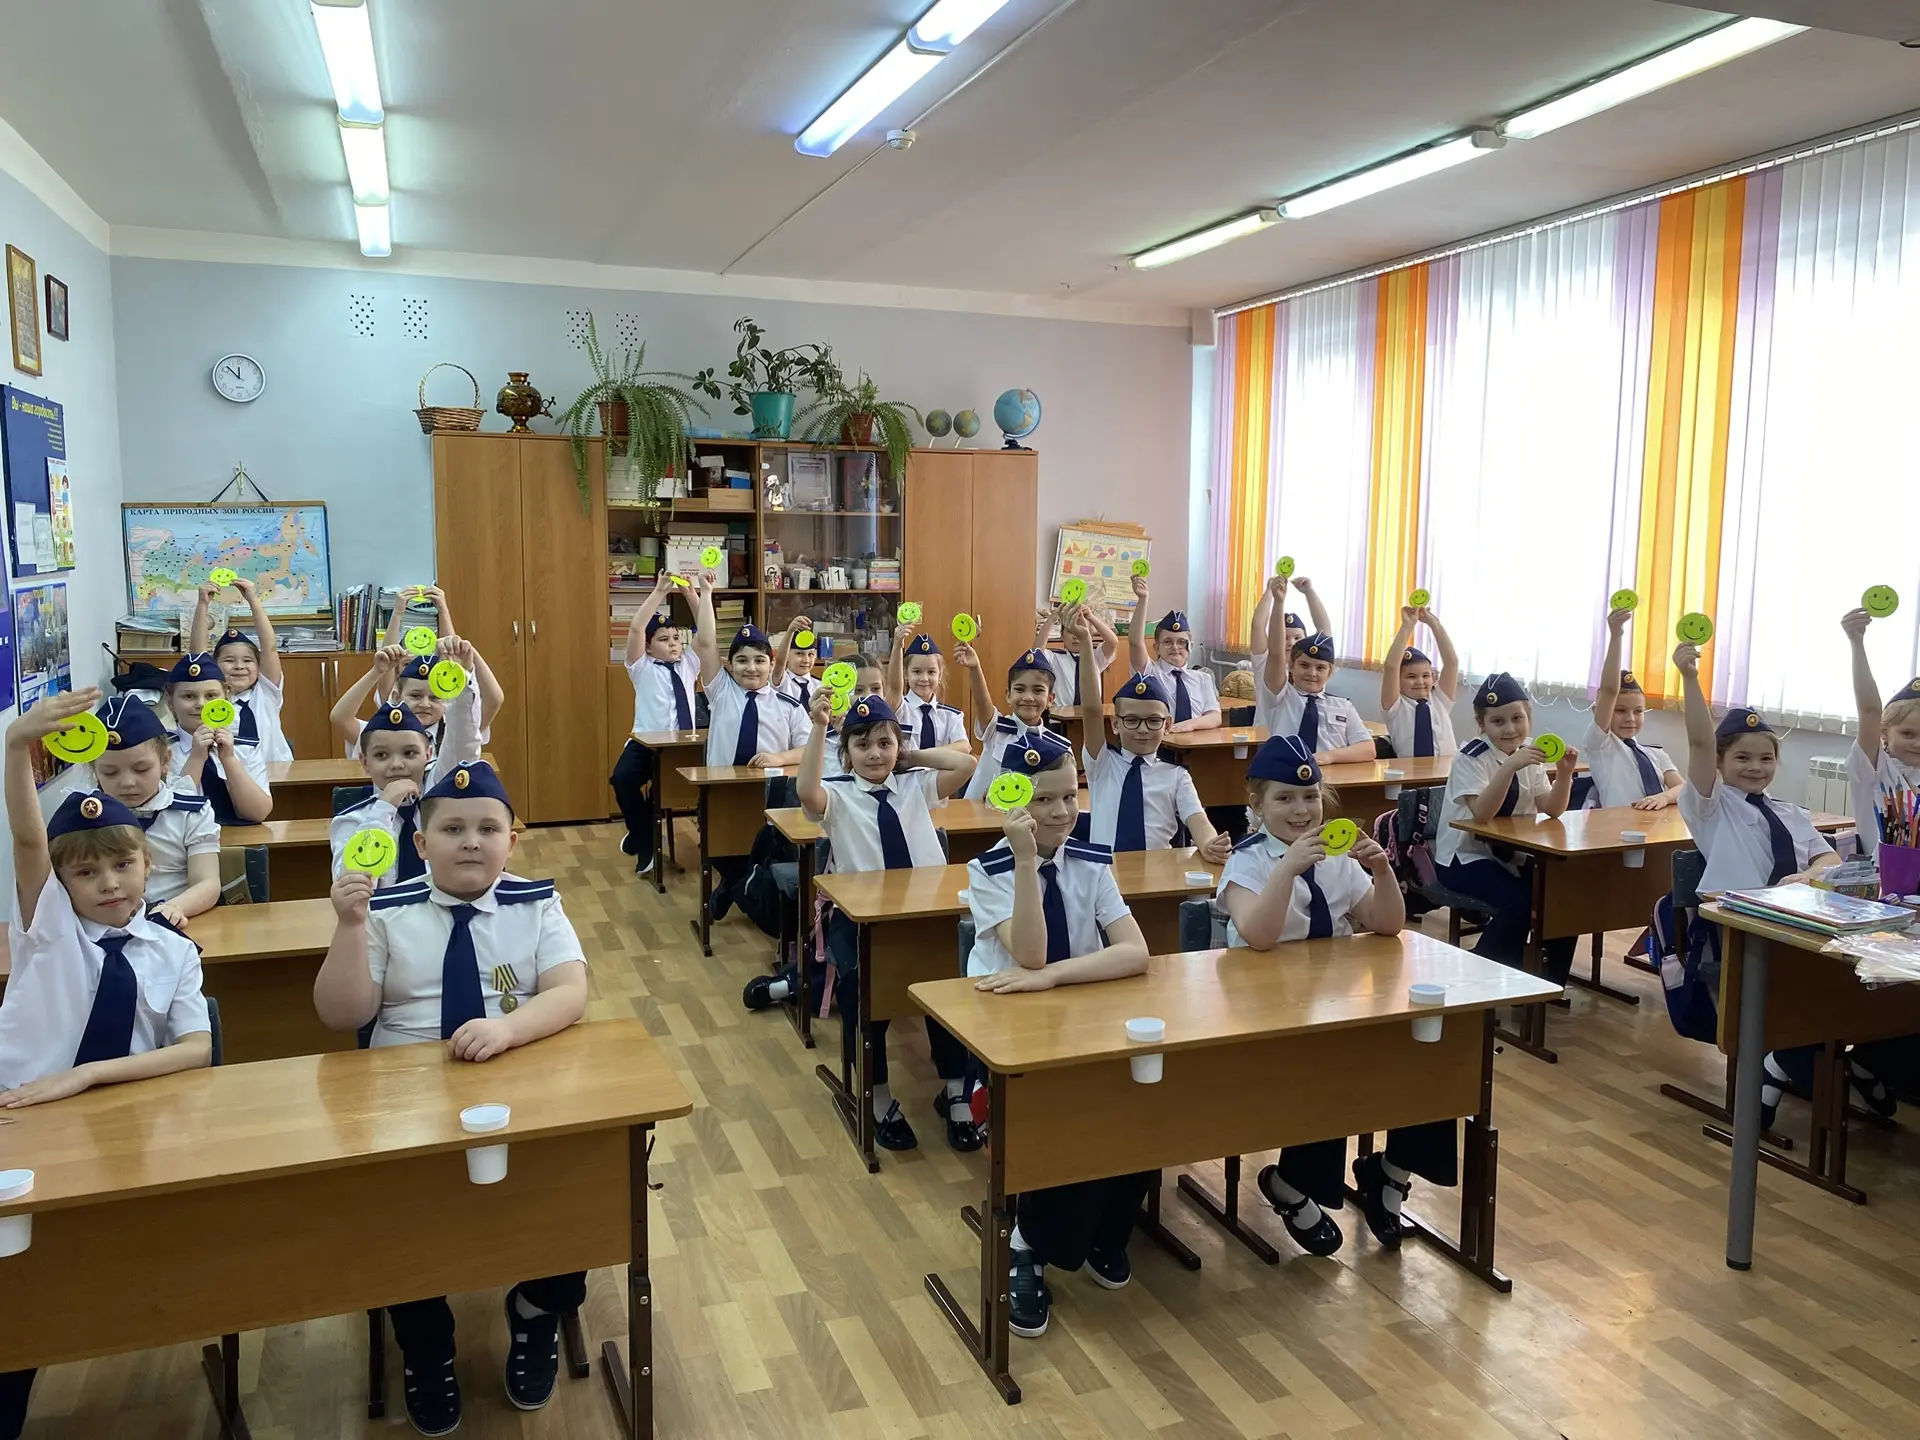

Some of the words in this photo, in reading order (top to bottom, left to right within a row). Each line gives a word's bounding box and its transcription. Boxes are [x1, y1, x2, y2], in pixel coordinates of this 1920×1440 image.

[12, 395, 18, 410] Вы
[22, 402, 34, 414] наша
[130, 508, 160, 516] КАРТА
[163, 508, 219, 516] ПРИРОДНЫХ
[835, 570, 842, 582] 1
